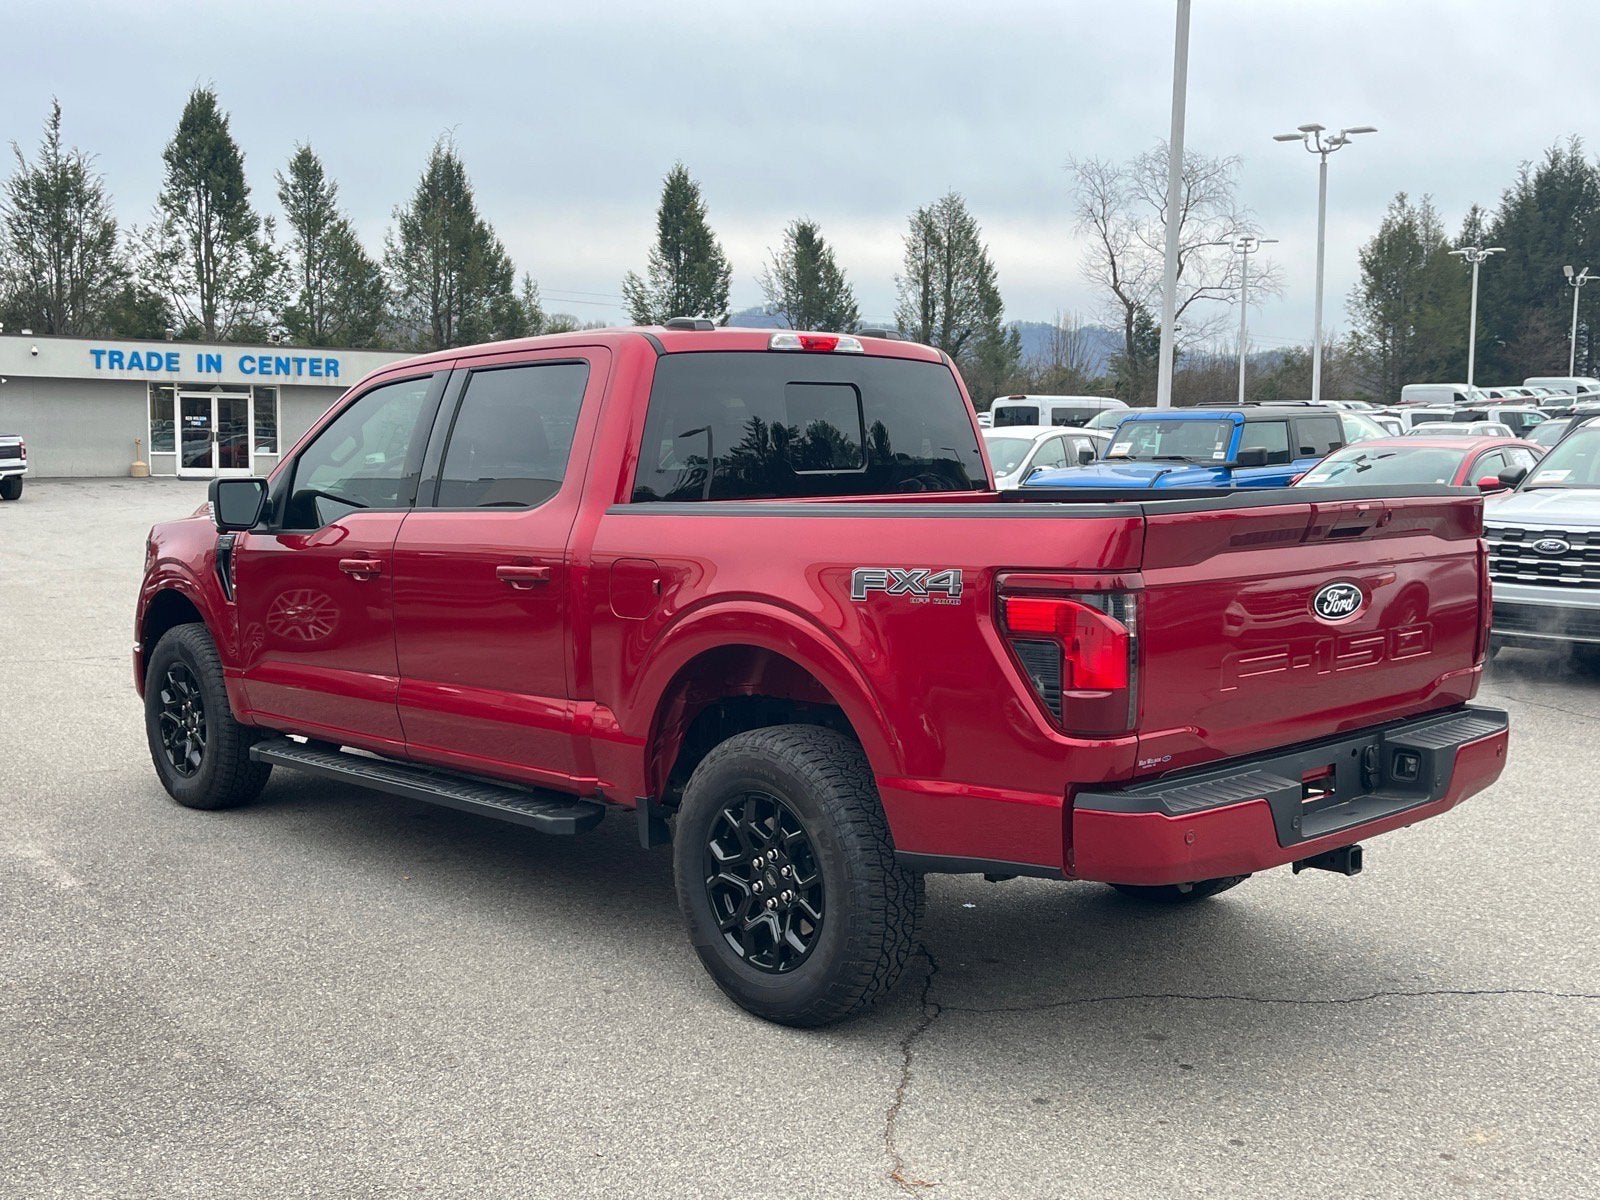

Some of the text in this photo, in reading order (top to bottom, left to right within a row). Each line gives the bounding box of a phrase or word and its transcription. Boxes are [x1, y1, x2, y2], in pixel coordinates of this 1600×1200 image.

[90, 348, 340, 377] TRADE IN CENTER
[1539, 541, 1561, 550] Ford
[851, 567, 963, 601] FX4
[1322, 587, 1356, 616] Ford
[1220, 621, 1434, 691] F-150
